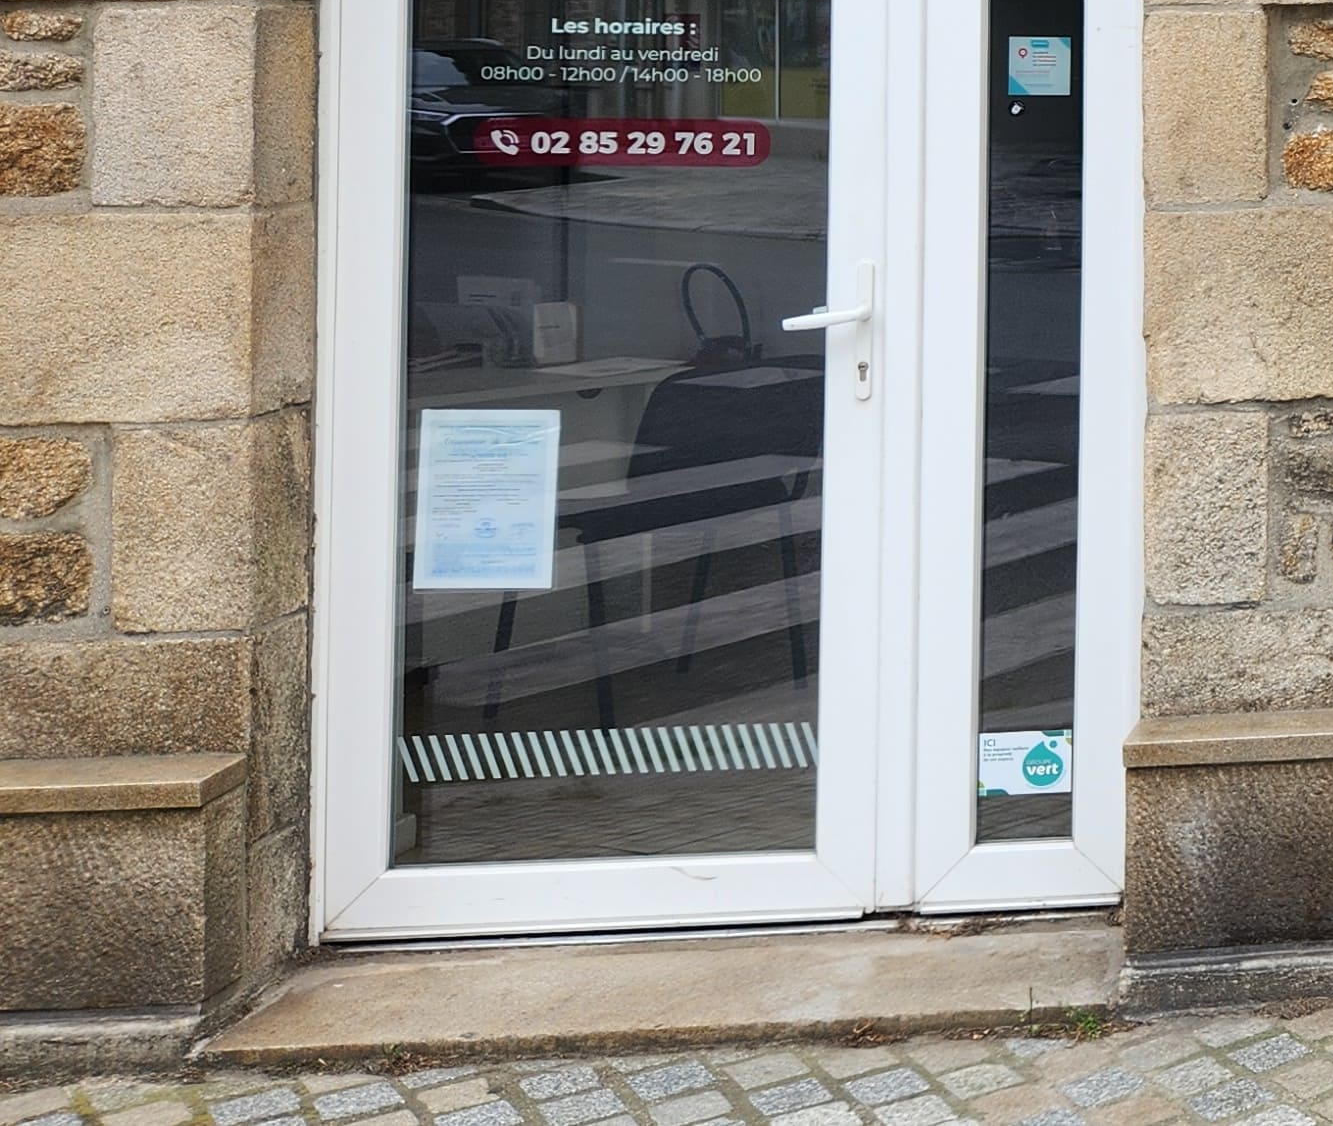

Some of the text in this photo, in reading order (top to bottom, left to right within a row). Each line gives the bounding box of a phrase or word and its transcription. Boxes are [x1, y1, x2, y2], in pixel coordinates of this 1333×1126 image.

[551, 18, 589, 34] Les
[594, 18, 685, 36] horaires
[527, 45, 719, 62] Du lundi au vendredi
[480, 66, 544, 81] 08h00
[560, 66, 616, 82] 12h00
[632, 67, 689, 83] 14h00
[705, 67, 762, 84] 18h00
[530, 131, 756, 156] 02 85 29 76 21
[983, 739, 996, 747] ICI
[1026, 763, 1059, 776] vert
